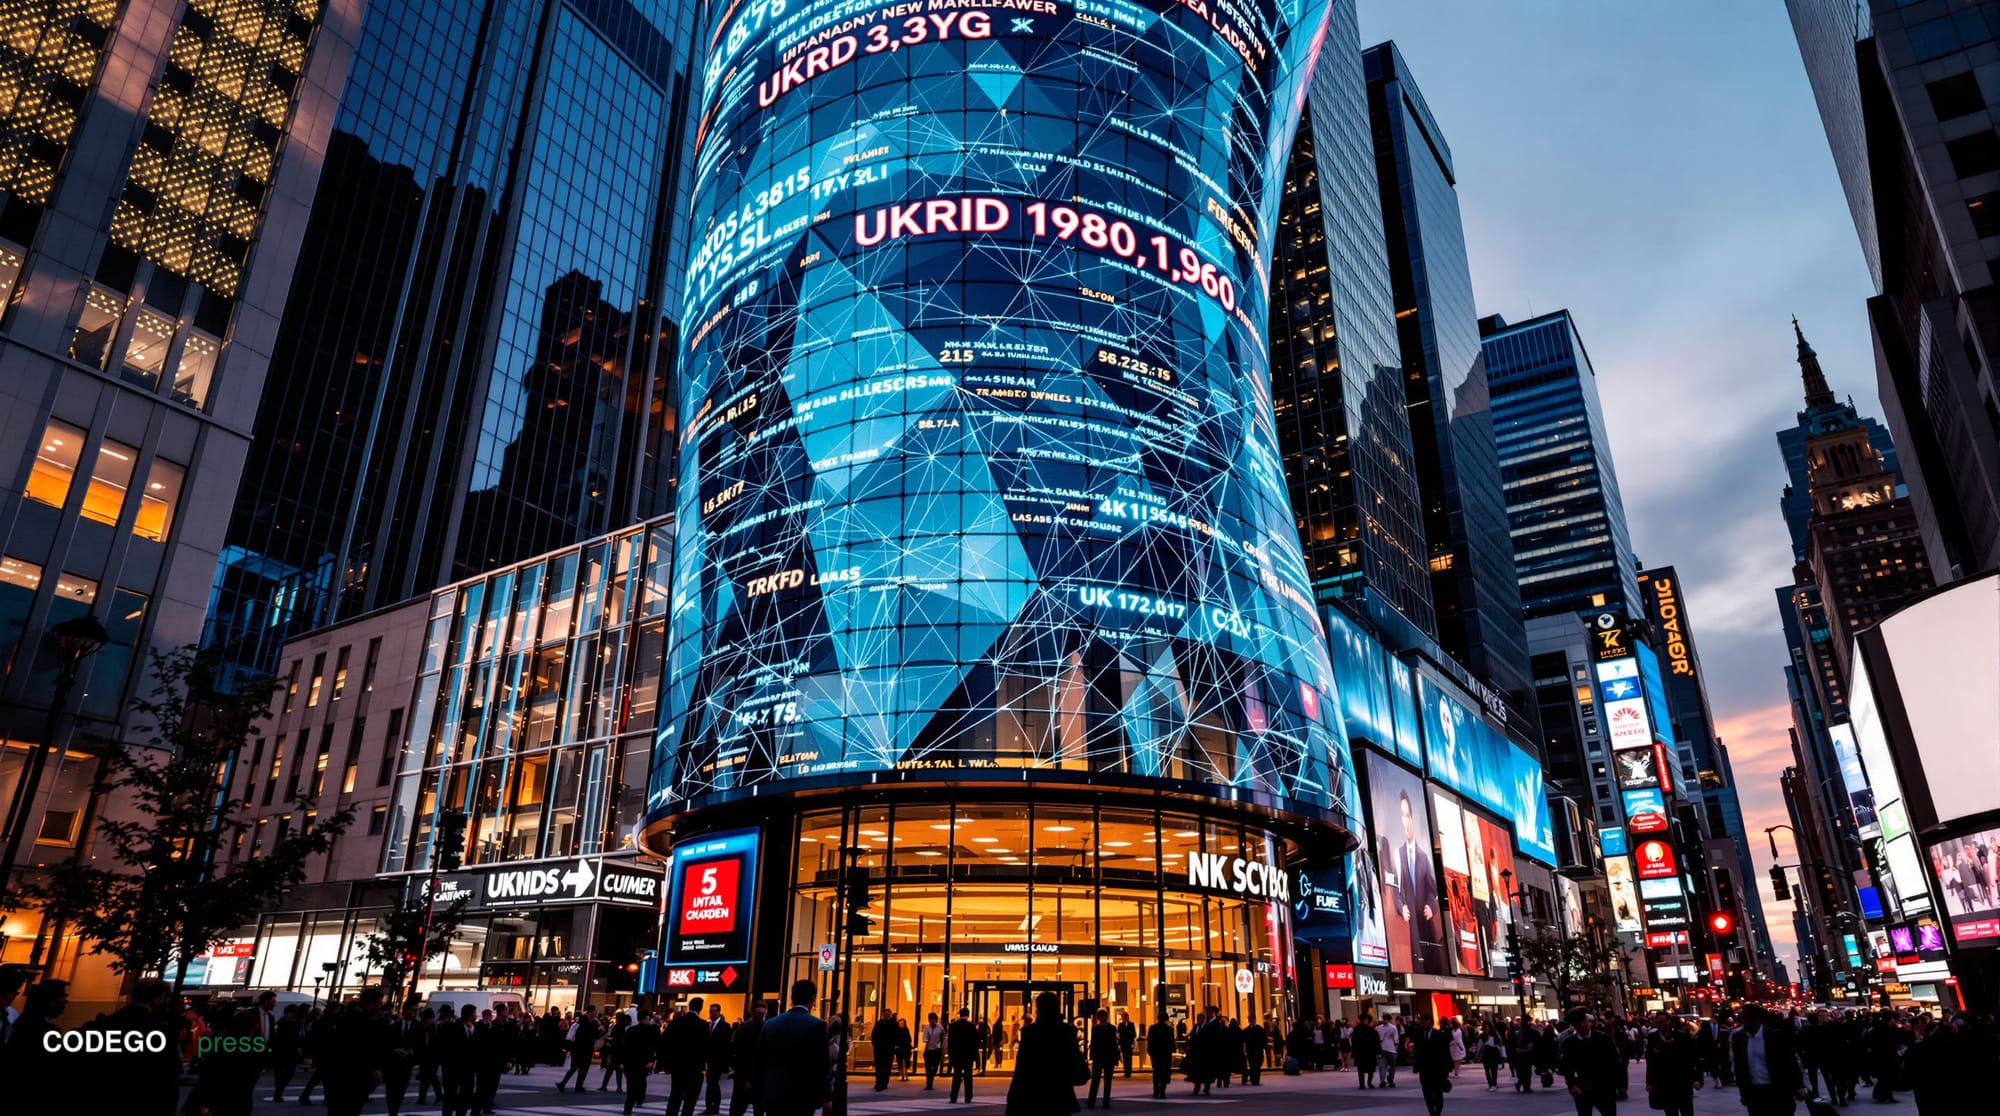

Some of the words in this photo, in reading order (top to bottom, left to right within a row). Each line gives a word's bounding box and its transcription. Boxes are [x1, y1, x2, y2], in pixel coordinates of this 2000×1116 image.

[882, 2, 923, 20] NEW
[757, 35, 858, 109] UKRD
[864, 10, 992, 53] 3,3YG
[854, 196, 1010, 248] UKRID
[1025, 200, 1235, 313] 1980,1,960
[939, 348, 975, 363] 215
[1079, 586, 1112, 608] UK
[487, 868, 561, 899] UKNDS
[701, 867, 718, 895] 5
[1188, 849, 1228, 890] NK
